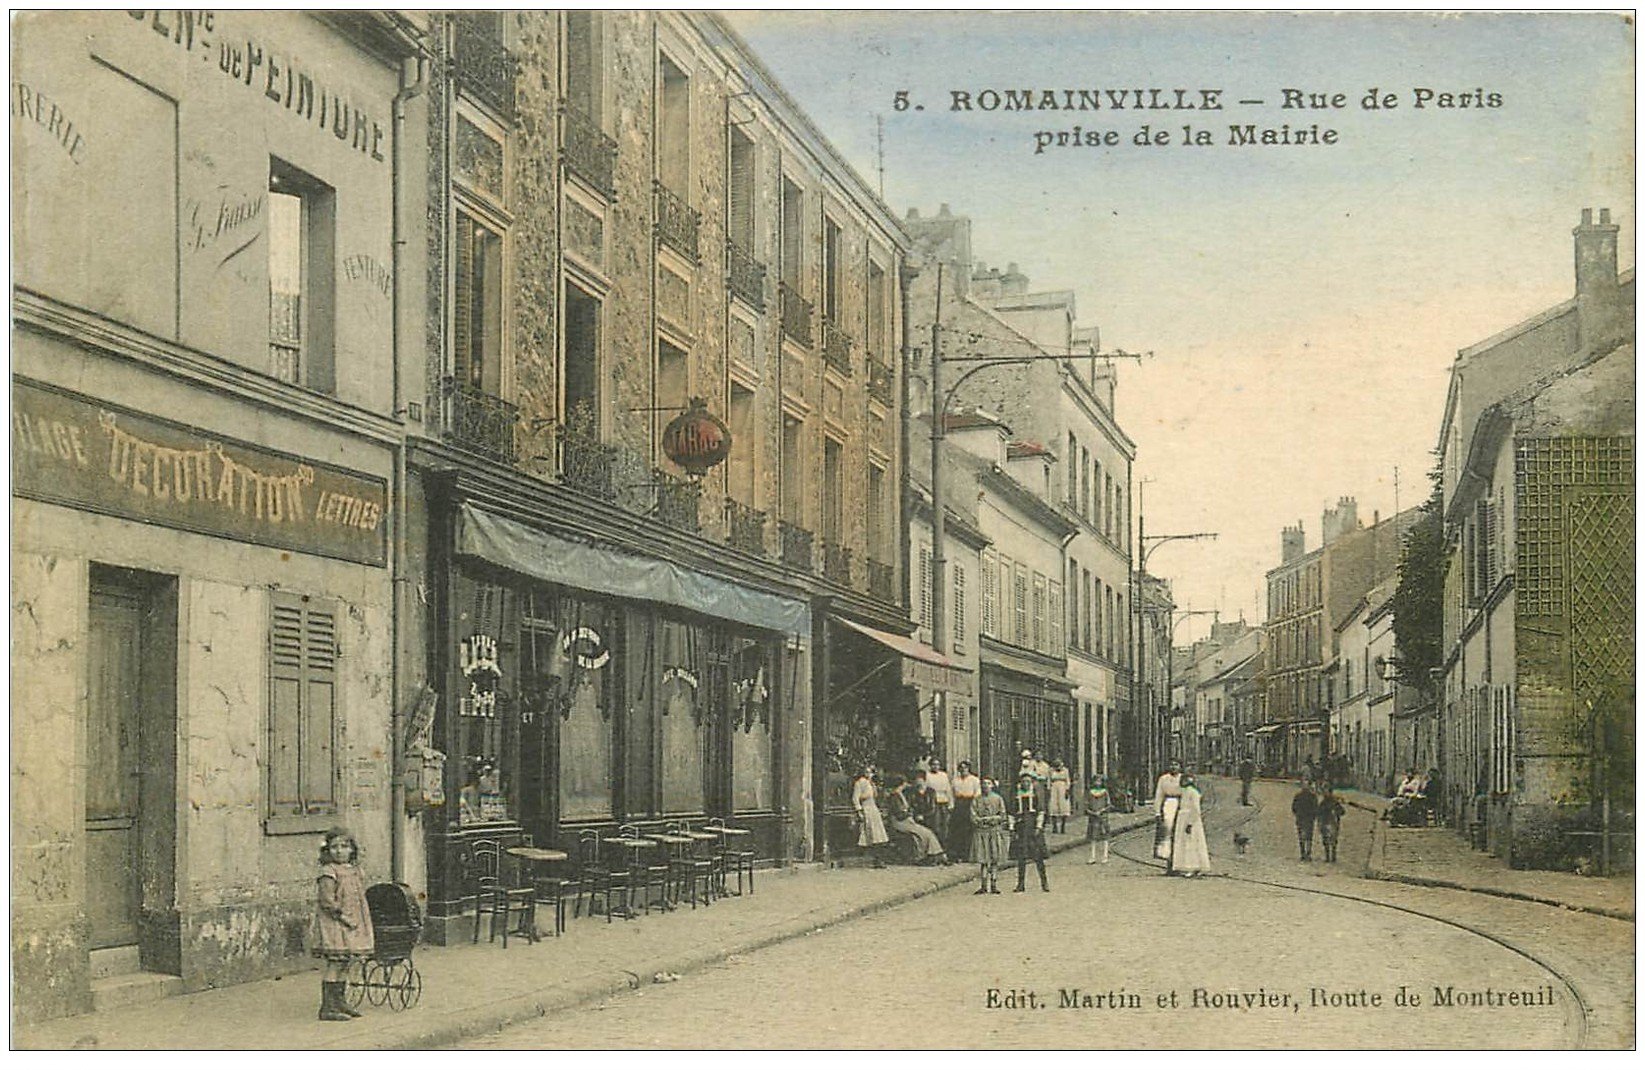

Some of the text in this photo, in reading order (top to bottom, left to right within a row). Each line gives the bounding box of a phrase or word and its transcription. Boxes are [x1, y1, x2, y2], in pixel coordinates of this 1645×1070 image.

[12, 83, 86, 166] RERIE
[245, 41, 385, 163] PEINTURE
[315, 490, 381, 531] LETTRES
